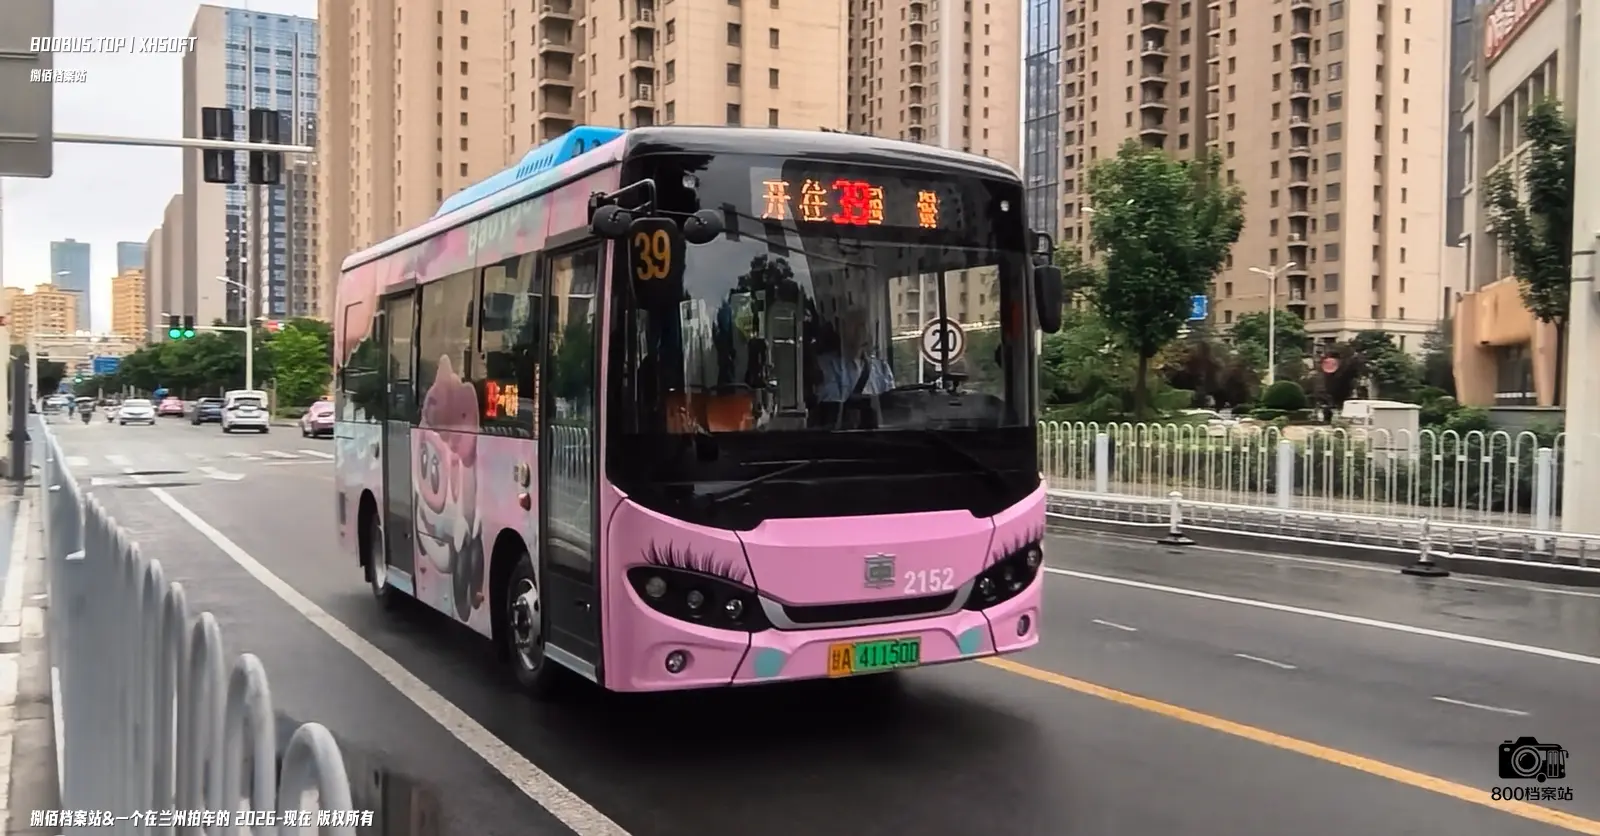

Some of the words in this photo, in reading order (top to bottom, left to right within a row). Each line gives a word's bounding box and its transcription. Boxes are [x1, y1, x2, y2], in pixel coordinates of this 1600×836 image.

[634, 229, 671, 280] 39
[930, 329, 957, 352] 20
[904, 567, 954, 594] 2152
